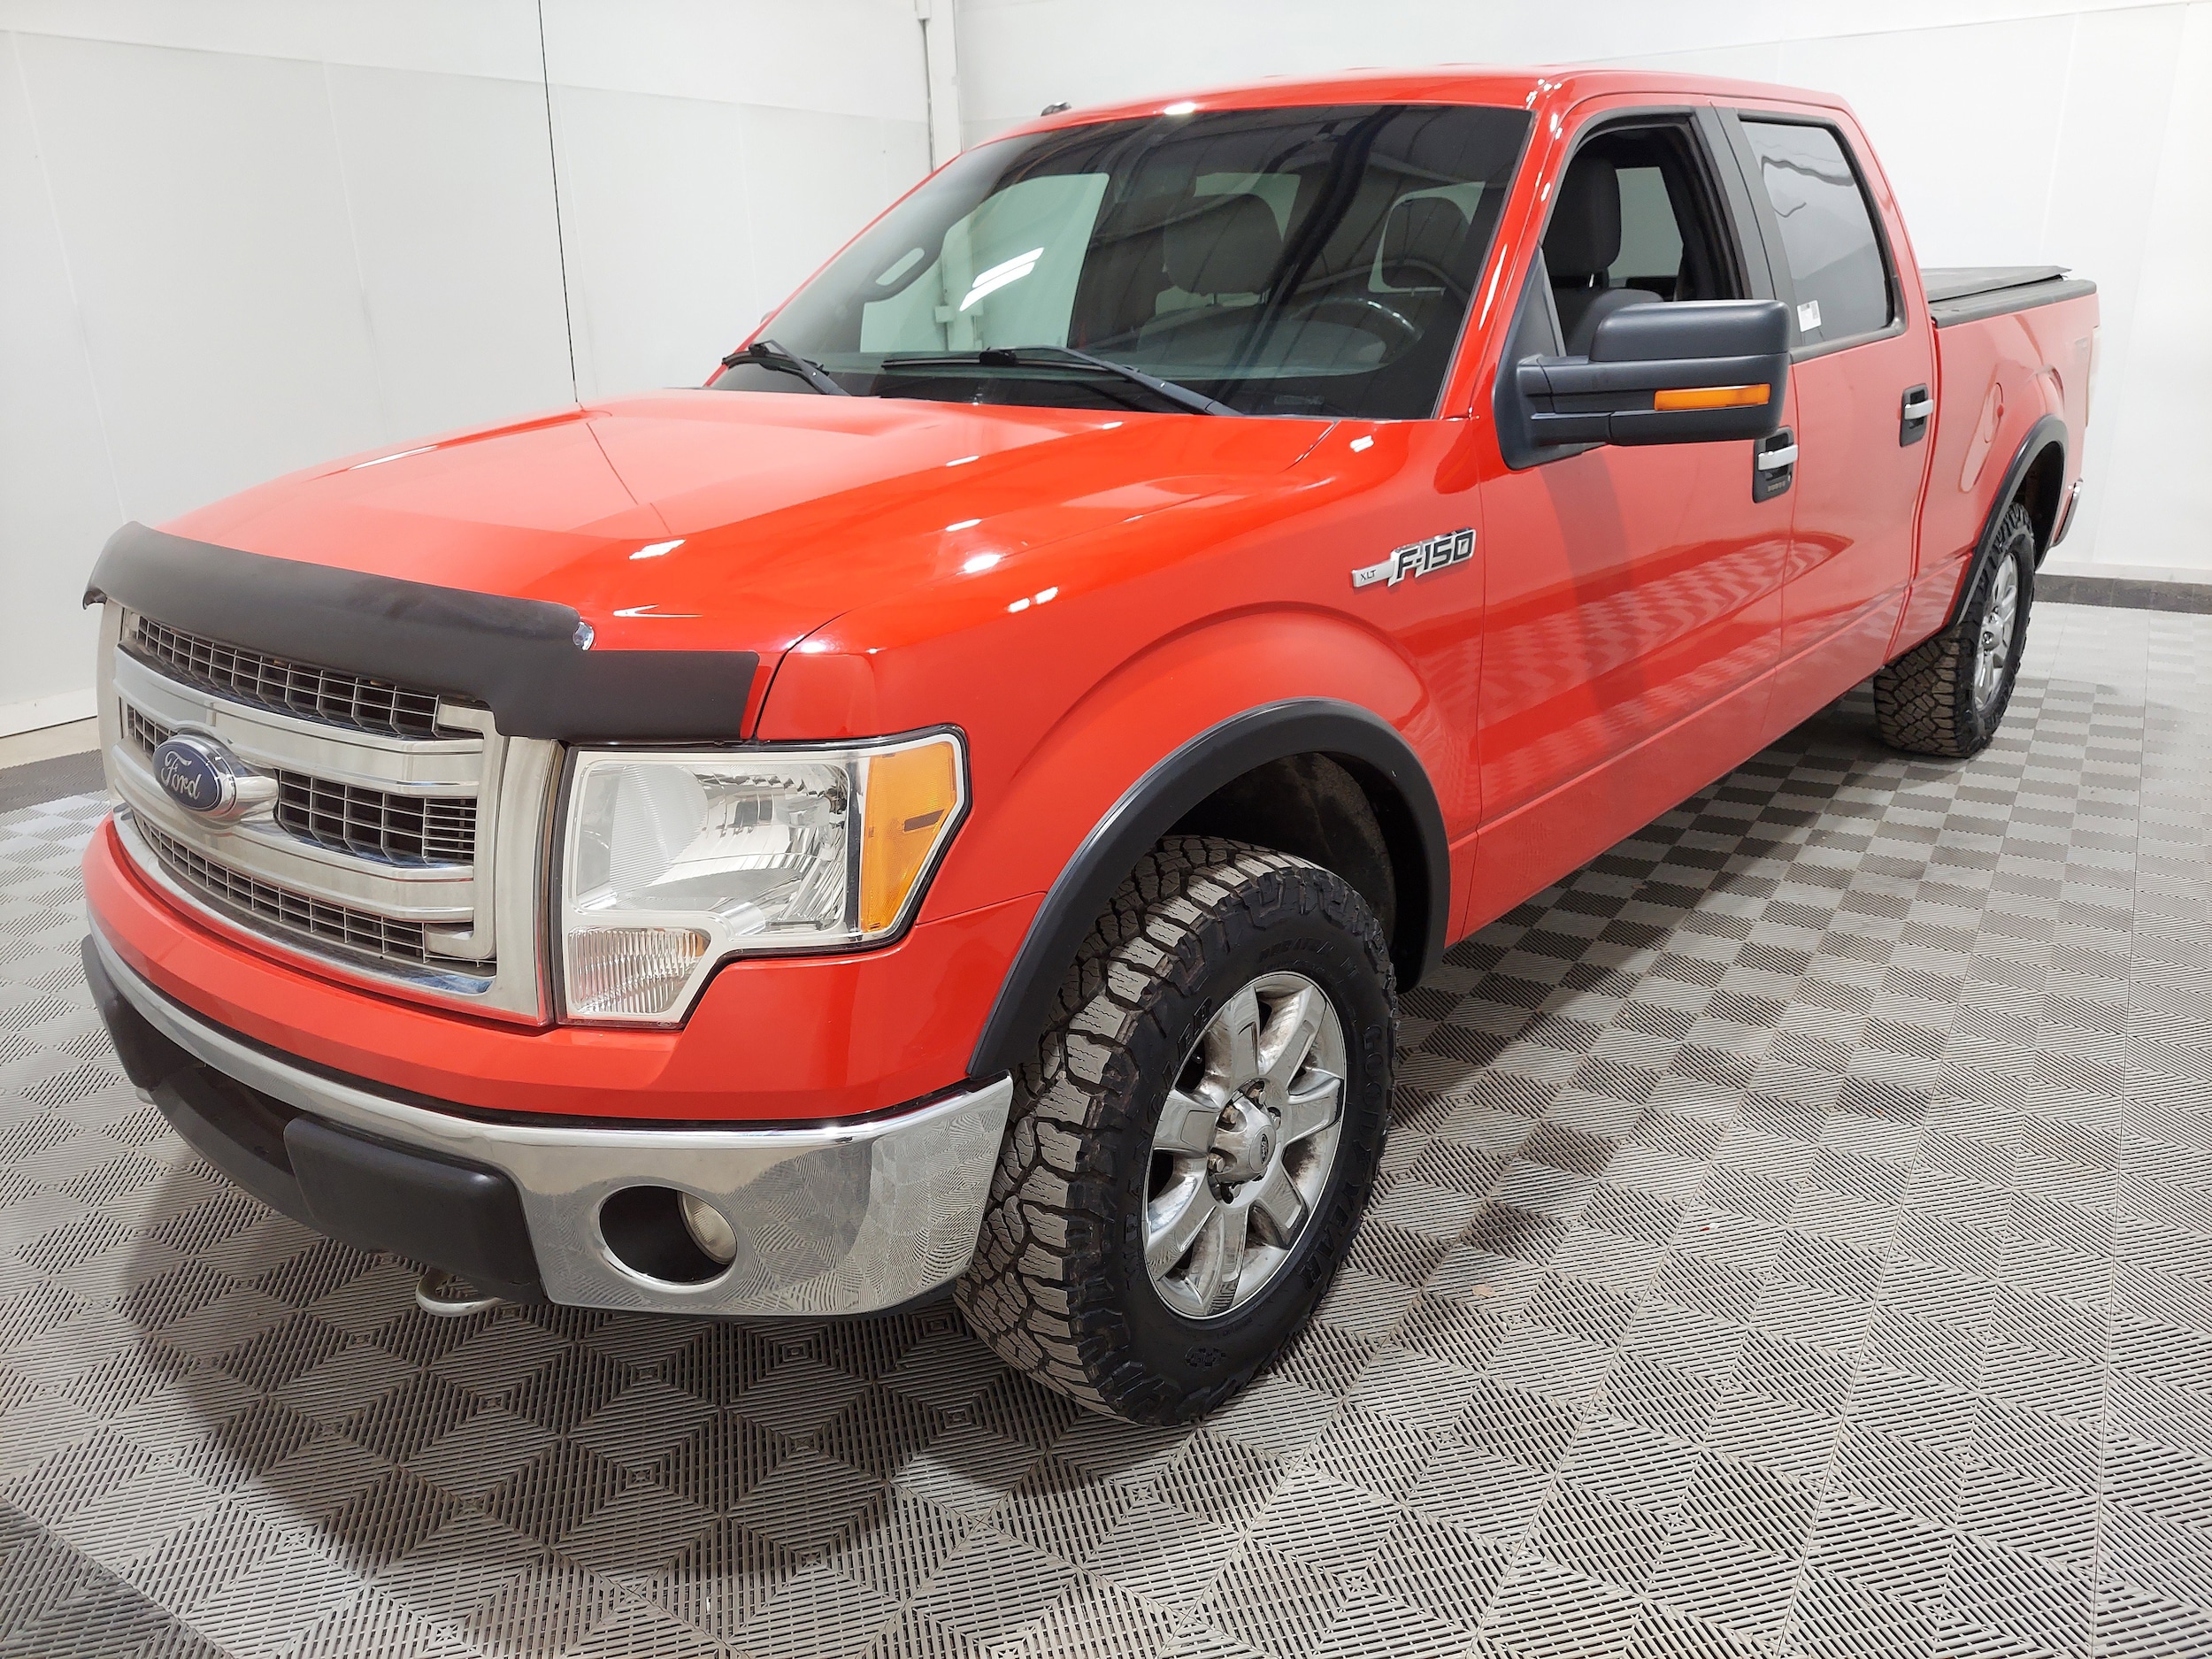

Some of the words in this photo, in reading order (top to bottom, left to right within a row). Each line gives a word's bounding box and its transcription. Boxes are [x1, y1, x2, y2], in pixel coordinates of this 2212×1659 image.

[1361, 569, 1377, 581] XLT
[1389, 529, 1477, 587] F-150
[161, 751, 202, 800] Ford
[1298, 1024, 1382, 1291] GOODYEAR
